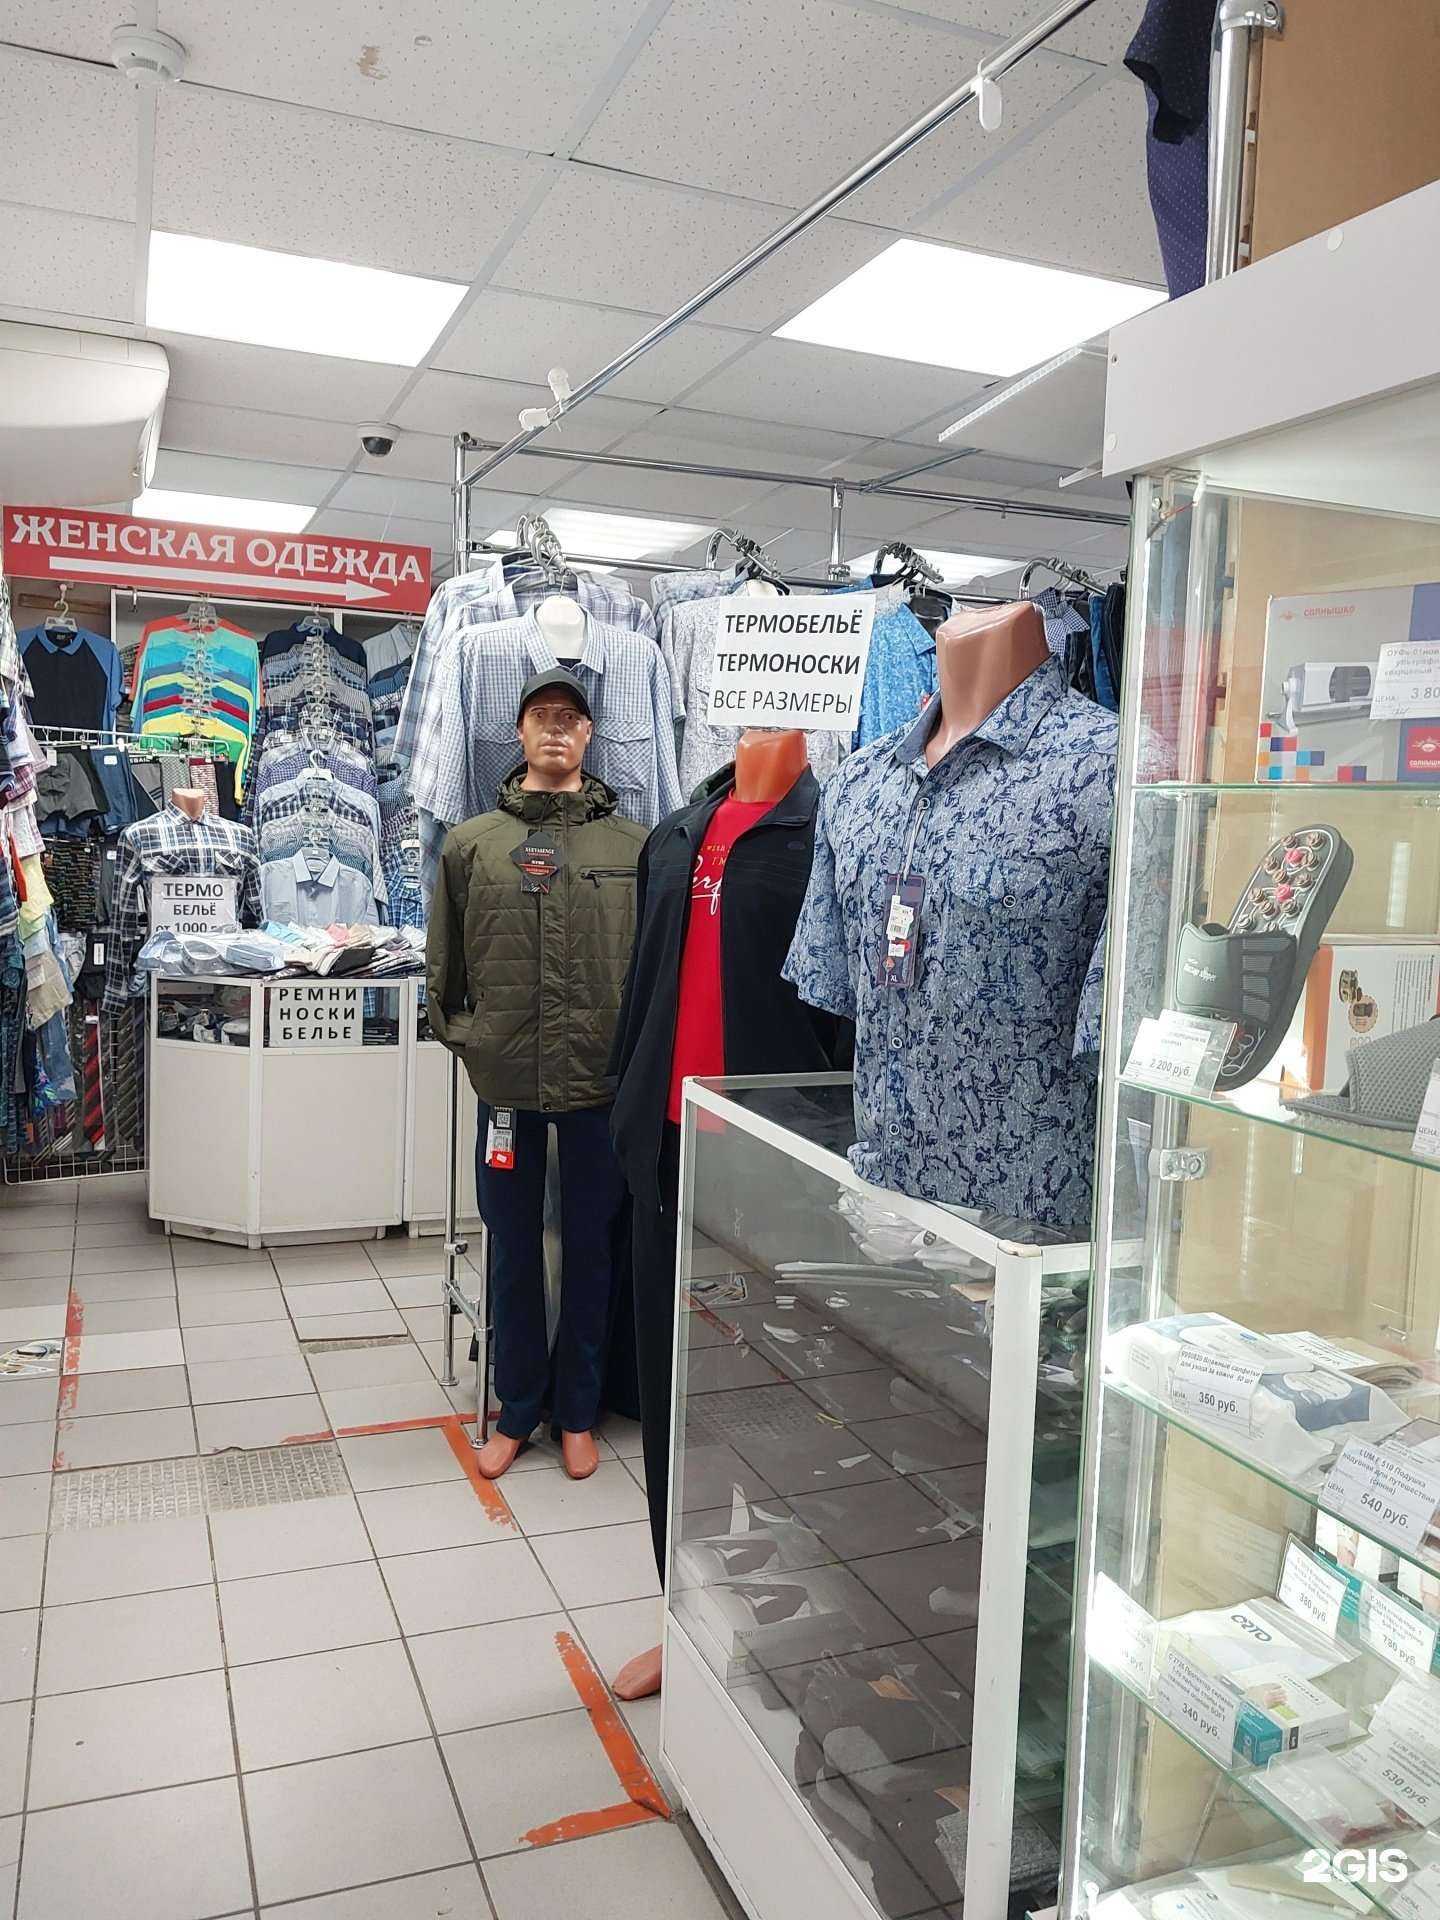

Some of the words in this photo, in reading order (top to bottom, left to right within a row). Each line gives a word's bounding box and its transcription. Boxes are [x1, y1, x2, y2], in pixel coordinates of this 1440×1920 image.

[10, 513, 235, 564] ЖЕНСКАЯ
[246, 537, 425, 586] ОДЕЖДА
[725, 608, 863, 635] ТЕРМОБЕЛЬЁ
[716, 652, 861, 675] ТЕРМОНОСКИ
[713, 689, 747, 709] ВСЕ
[752, 690, 853, 714] РАЗМЕРЫ
[163, 881, 224, 898] ТЕРМО
[173, 902, 217, 916] БЕЛЬЁ
[174, 922, 208, 933] 1000
[279, 988, 357, 1001] РЕМНИ
[279, 1007, 356, 1020] НОСКИ
[282, 1026, 353, 1040] БЕЛЬЕ
[1156, 1059, 1172, 1072] 200
[1198, 1391, 1215, 1406] 350
[1217, 1398, 1239, 1413] руб.
[1394, 1465, 1426, 1488] Подушка
[1360, 1493, 1382, 1512] 540
[1382, 1503, 1409, 1528] руб.
[1182, 1702, 1198, 1722] 340
[1200, 1718, 1220, 1740] руб.
[1382, 1768, 1404, 1786] 530
[1403, 1784, 1429, 1808] руб.
